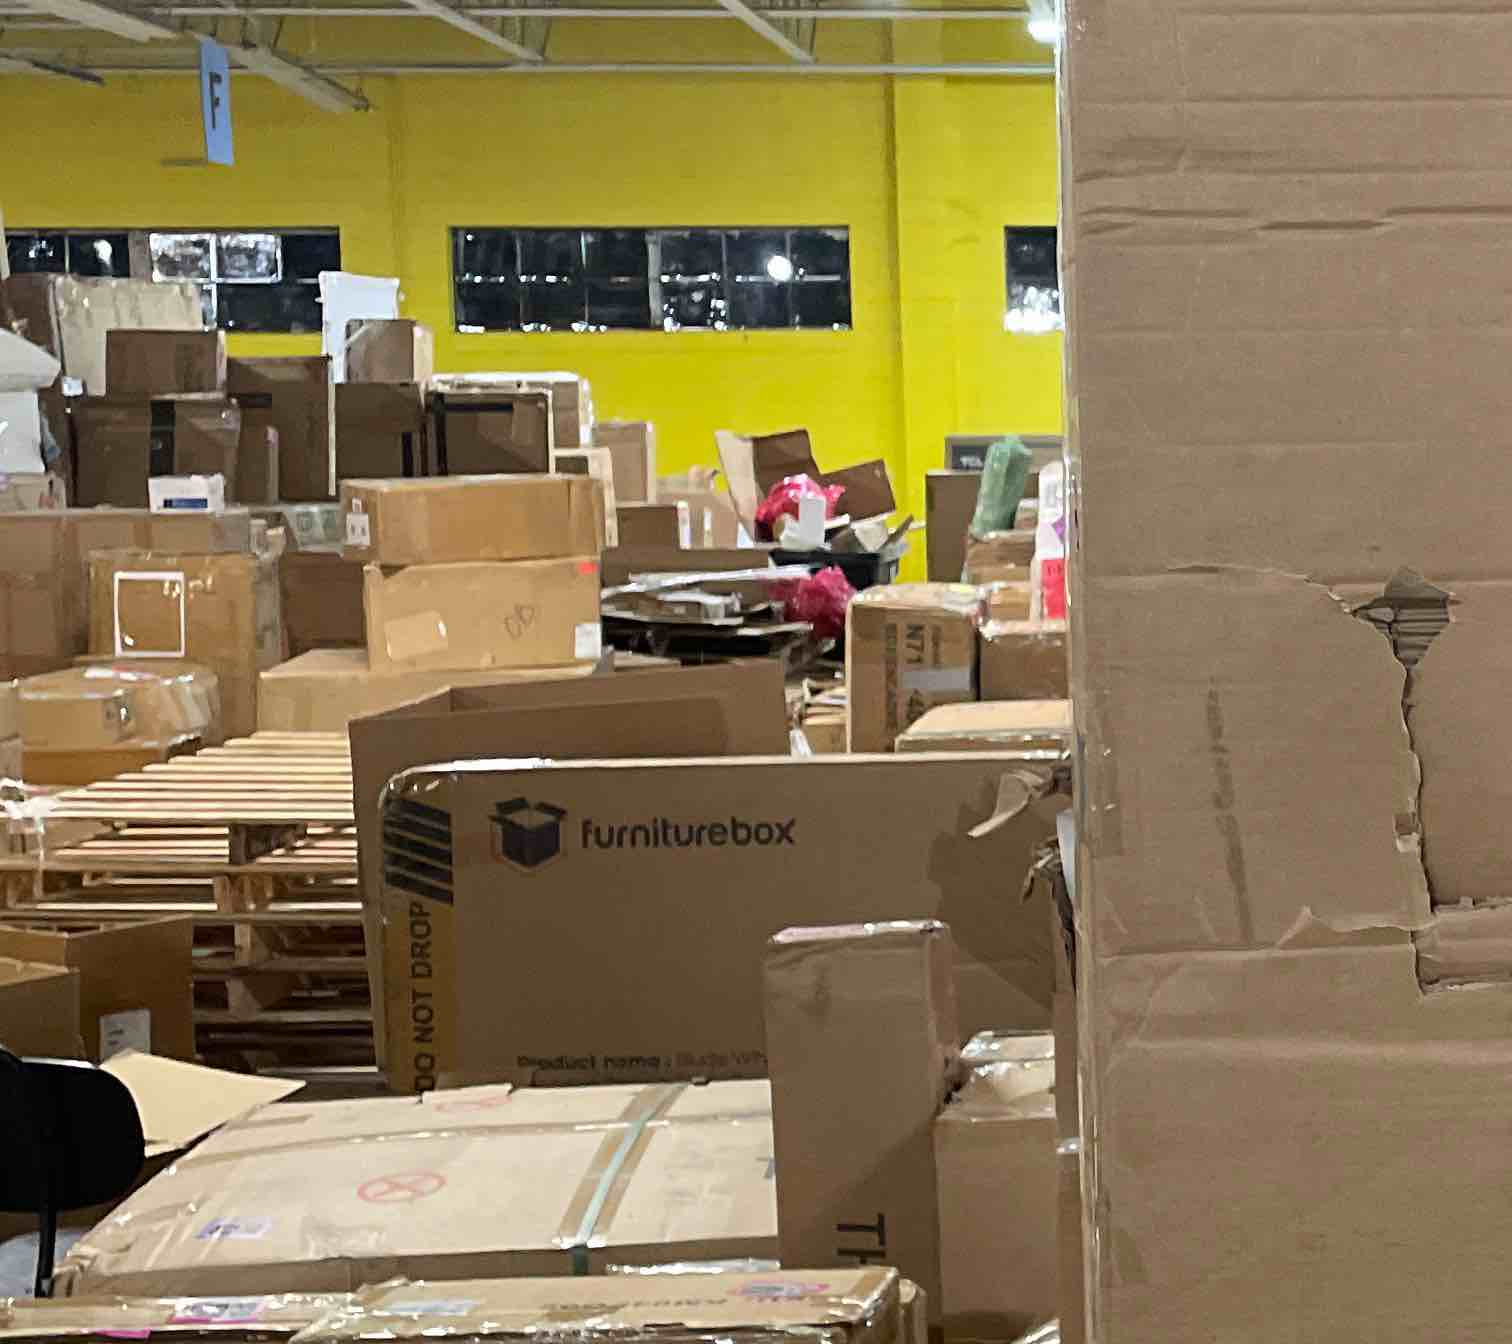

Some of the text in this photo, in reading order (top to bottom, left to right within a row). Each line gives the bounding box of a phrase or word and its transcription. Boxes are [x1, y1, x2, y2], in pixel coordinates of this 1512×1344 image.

[582, 816, 796, 849] furniturebox
[409, 902, 435, 1094] DO NOT DROP
